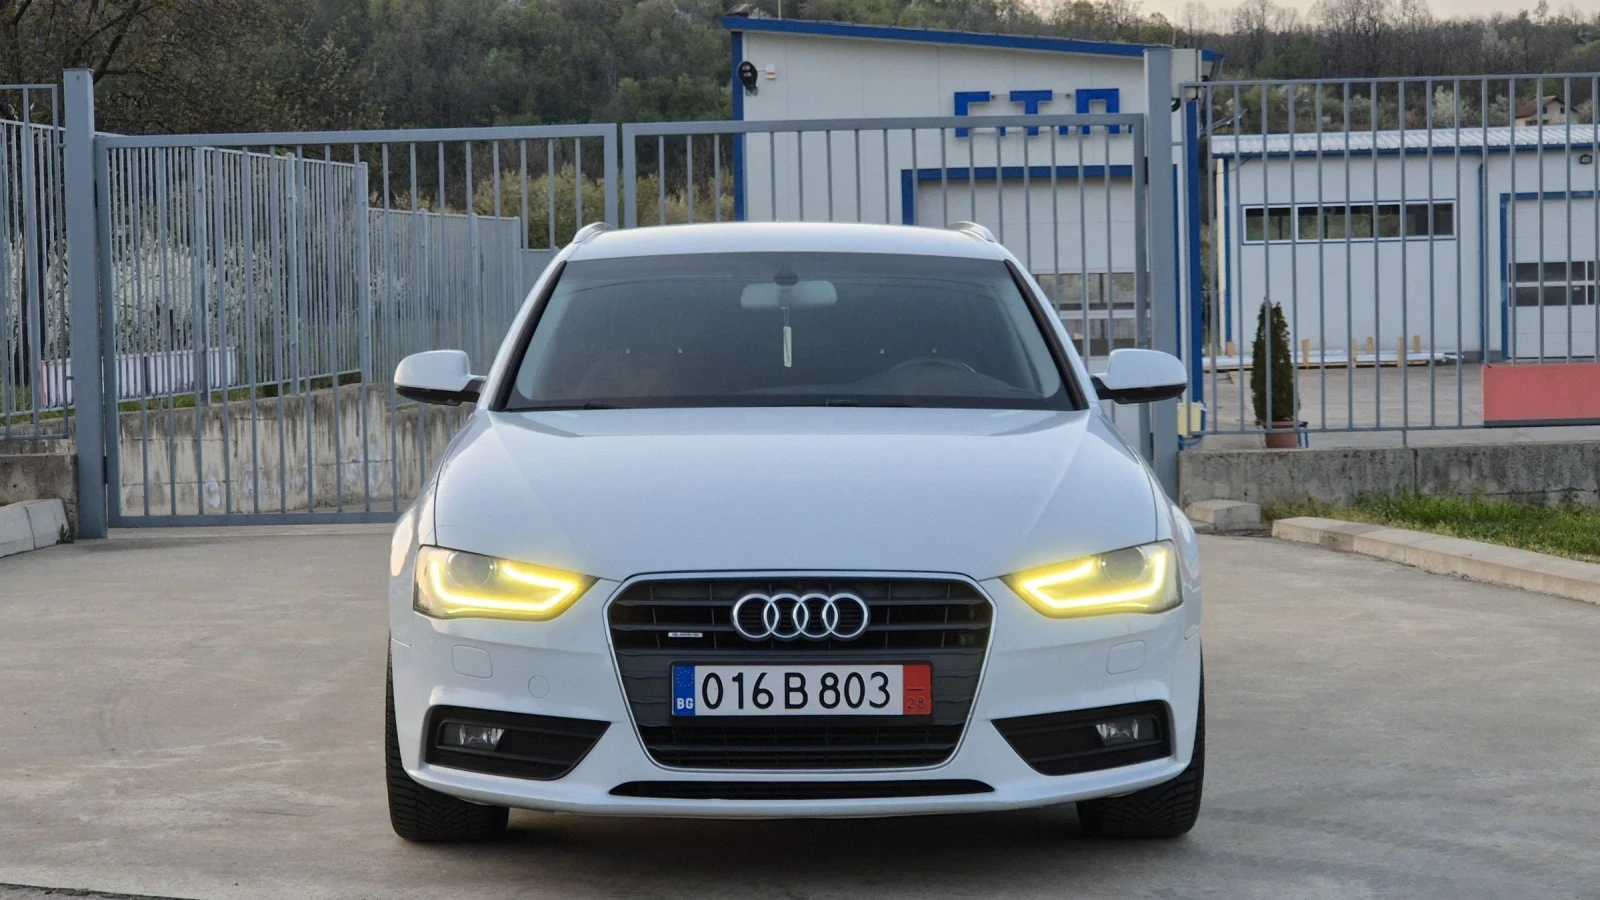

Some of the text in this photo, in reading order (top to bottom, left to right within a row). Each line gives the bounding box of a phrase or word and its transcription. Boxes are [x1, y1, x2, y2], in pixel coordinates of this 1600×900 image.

[702, 672, 890, 709] 016 B 803
[676, 698, 694, 710] BG
[907, 696, 925, 709] 28
